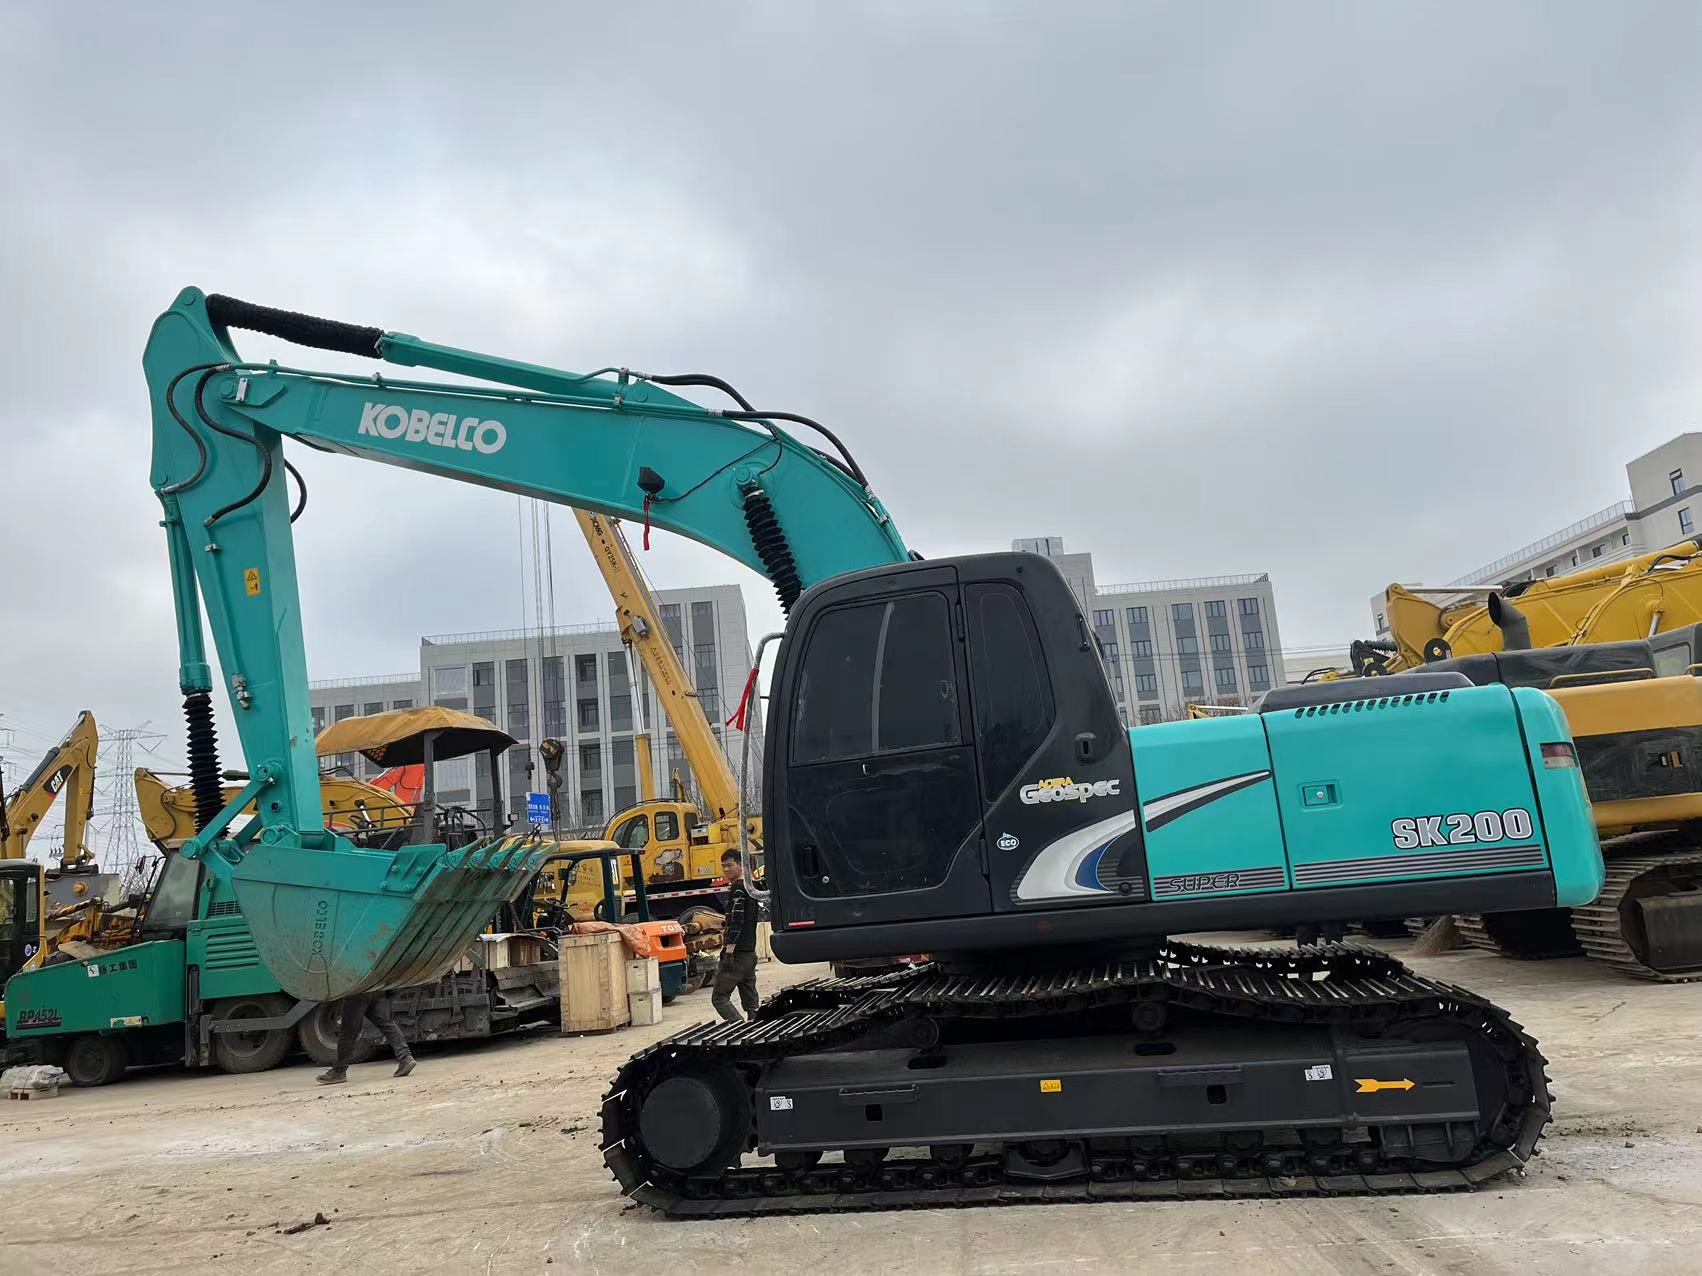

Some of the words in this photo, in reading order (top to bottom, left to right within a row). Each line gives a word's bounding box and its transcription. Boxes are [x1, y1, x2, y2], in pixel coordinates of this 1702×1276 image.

[358, 401, 507, 454] KOBELCO
[50, 770, 64, 793] CAT
[1000, 839, 1017, 847] ECO
[1392, 807, 1534, 850] SK200
[1168, 873, 1241, 893] SUPER
[311, 900, 328, 956] KOBELCO
